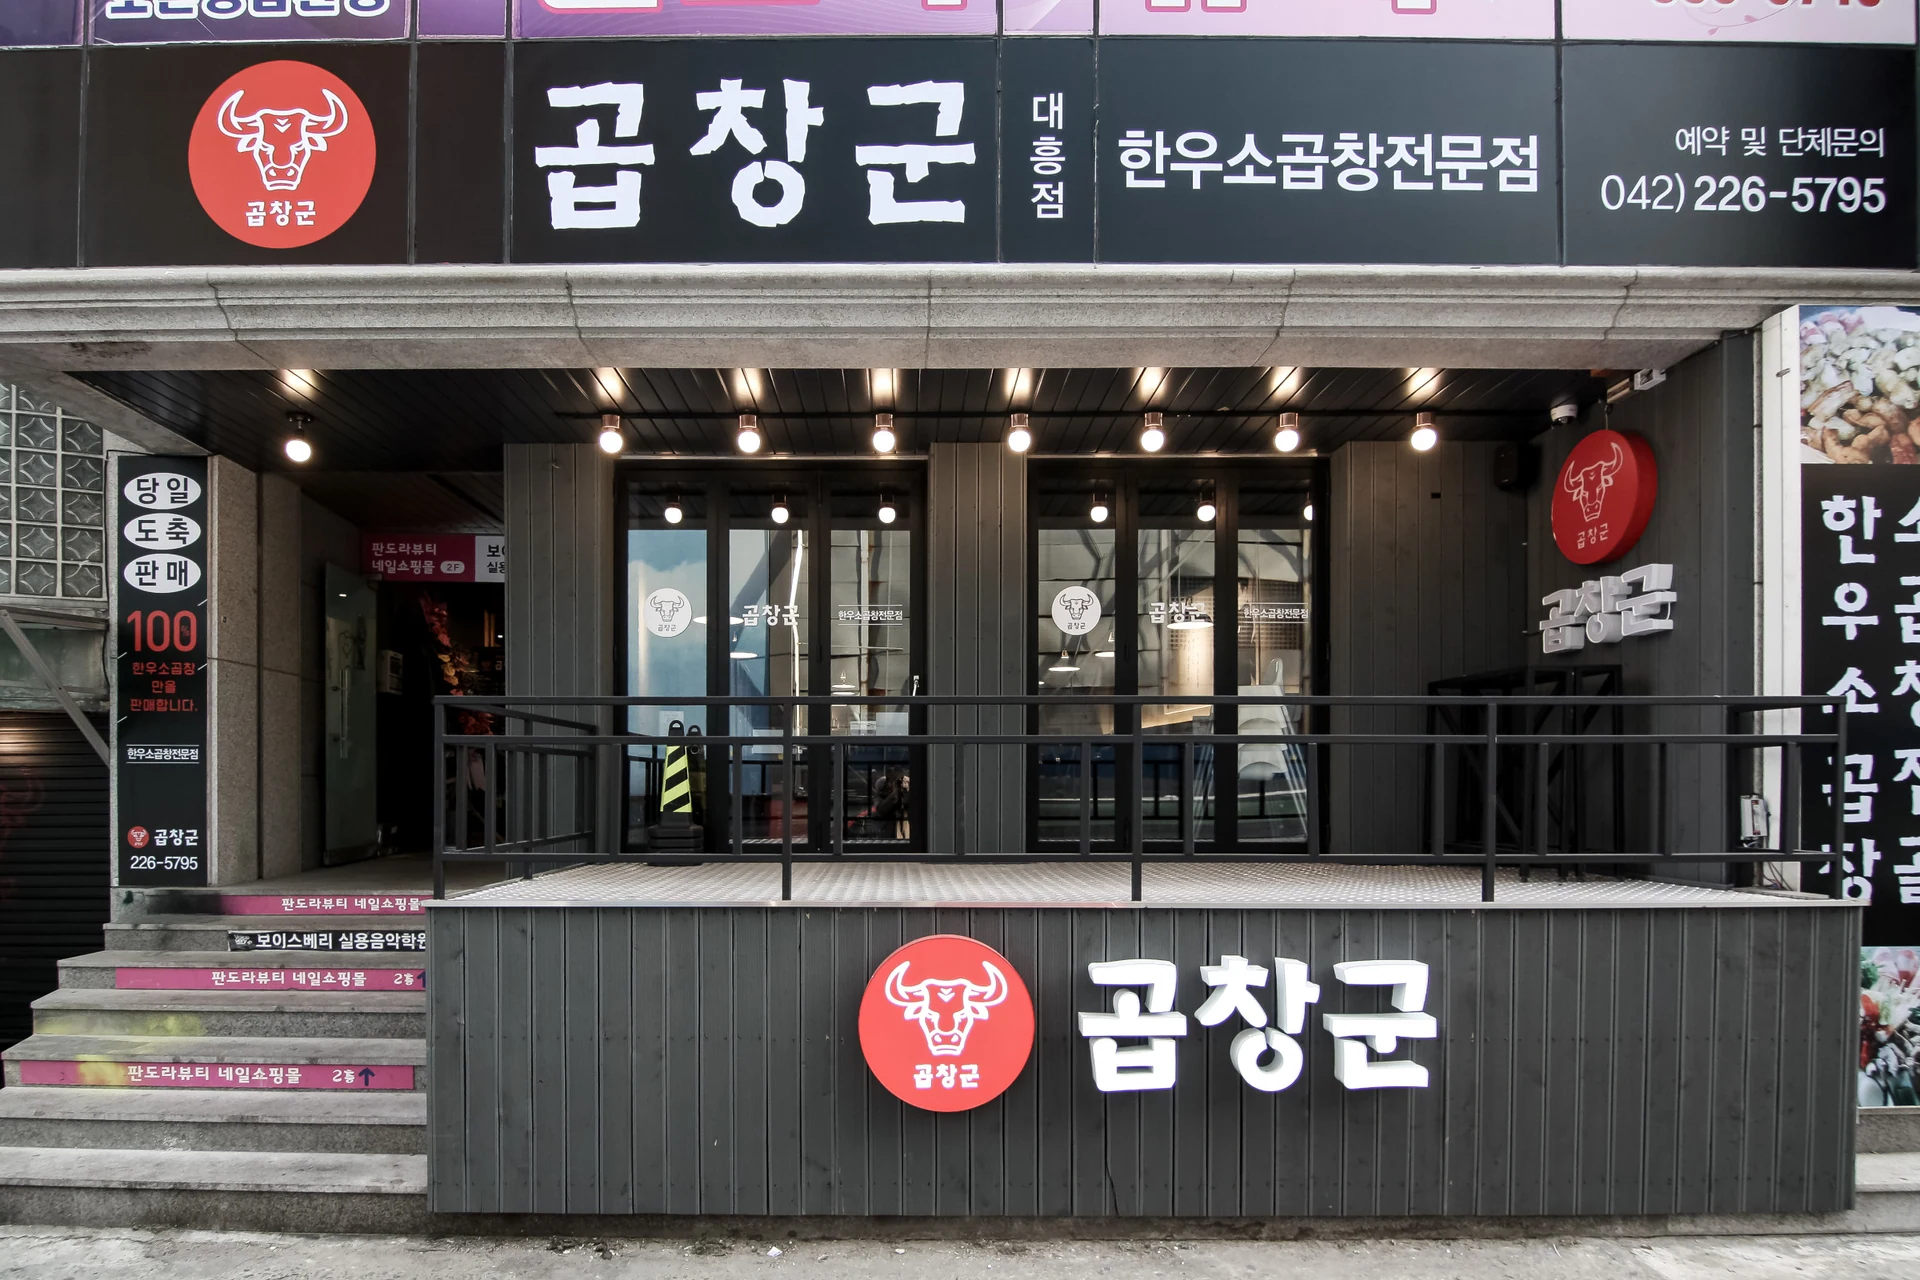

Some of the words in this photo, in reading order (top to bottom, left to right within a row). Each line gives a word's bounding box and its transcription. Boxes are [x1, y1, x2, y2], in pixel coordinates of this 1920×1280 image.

[1675, 126, 1730, 157] 예약
[1741, 127, 1767, 157] 및
[1778, 127, 1885, 158] 단체문의
[535, 79, 976, 229] 곱창군
[1030, 92, 1066, 219] 대흥점
[1118, 130, 1538, 193] 한우소곱창전문점
[246, 201, 316, 227] 곱창군
[137, 478, 188, 504] 당일
[135, 518, 189, 545] 도축
[1577, 522, 1609, 550] 곱창군
[371, 542, 437, 557] 판도라뷰티
[487, 544, 505, 557] 보
[135, 561, 188, 586] 판매
[372, 560, 435, 575] 네일쇼핑몰
[446, 562, 460, 572] 2F
[742, 604, 800, 627] 곱창군
[838, 609, 903, 622] 한우소곱창전문점
[1148, 602, 1206, 625] 곱창군
[1244, 608, 1309, 620] 한우소곱창전문점
[1539, 563, 1677, 654] 곱창군
[657, 624, 677, 632] 곱창군
[1067, 622, 1086, 630] 곱창군
[132, 661, 196, 676] 한우소곱창
[151, 680, 177, 694] 만을
[130, 698, 198, 712] 판매합니다.
[127, 747, 199, 761] 한우소곱창전문점
[154, 828, 199, 846] 곱창군
[130, 855, 199, 870] 226-5795
[281, 897, 348, 912] 판도라뷰티
[354, 897, 421, 912] 네일쇼핑몰
[255, 931, 333, 949] 보이스베리
[211, 970, 285, 986] 판도라뷰티
[292, 970, 367, 987] 네일쇼핑몰
[1078, 954, 1437, 1092] 곱창군
[127, 1065, 210, 1083] 판도라뷰티
[218, 1065, 302, 1085] 네일쇼핑몰
[913, 1063, 980, 1089] 곱창군
